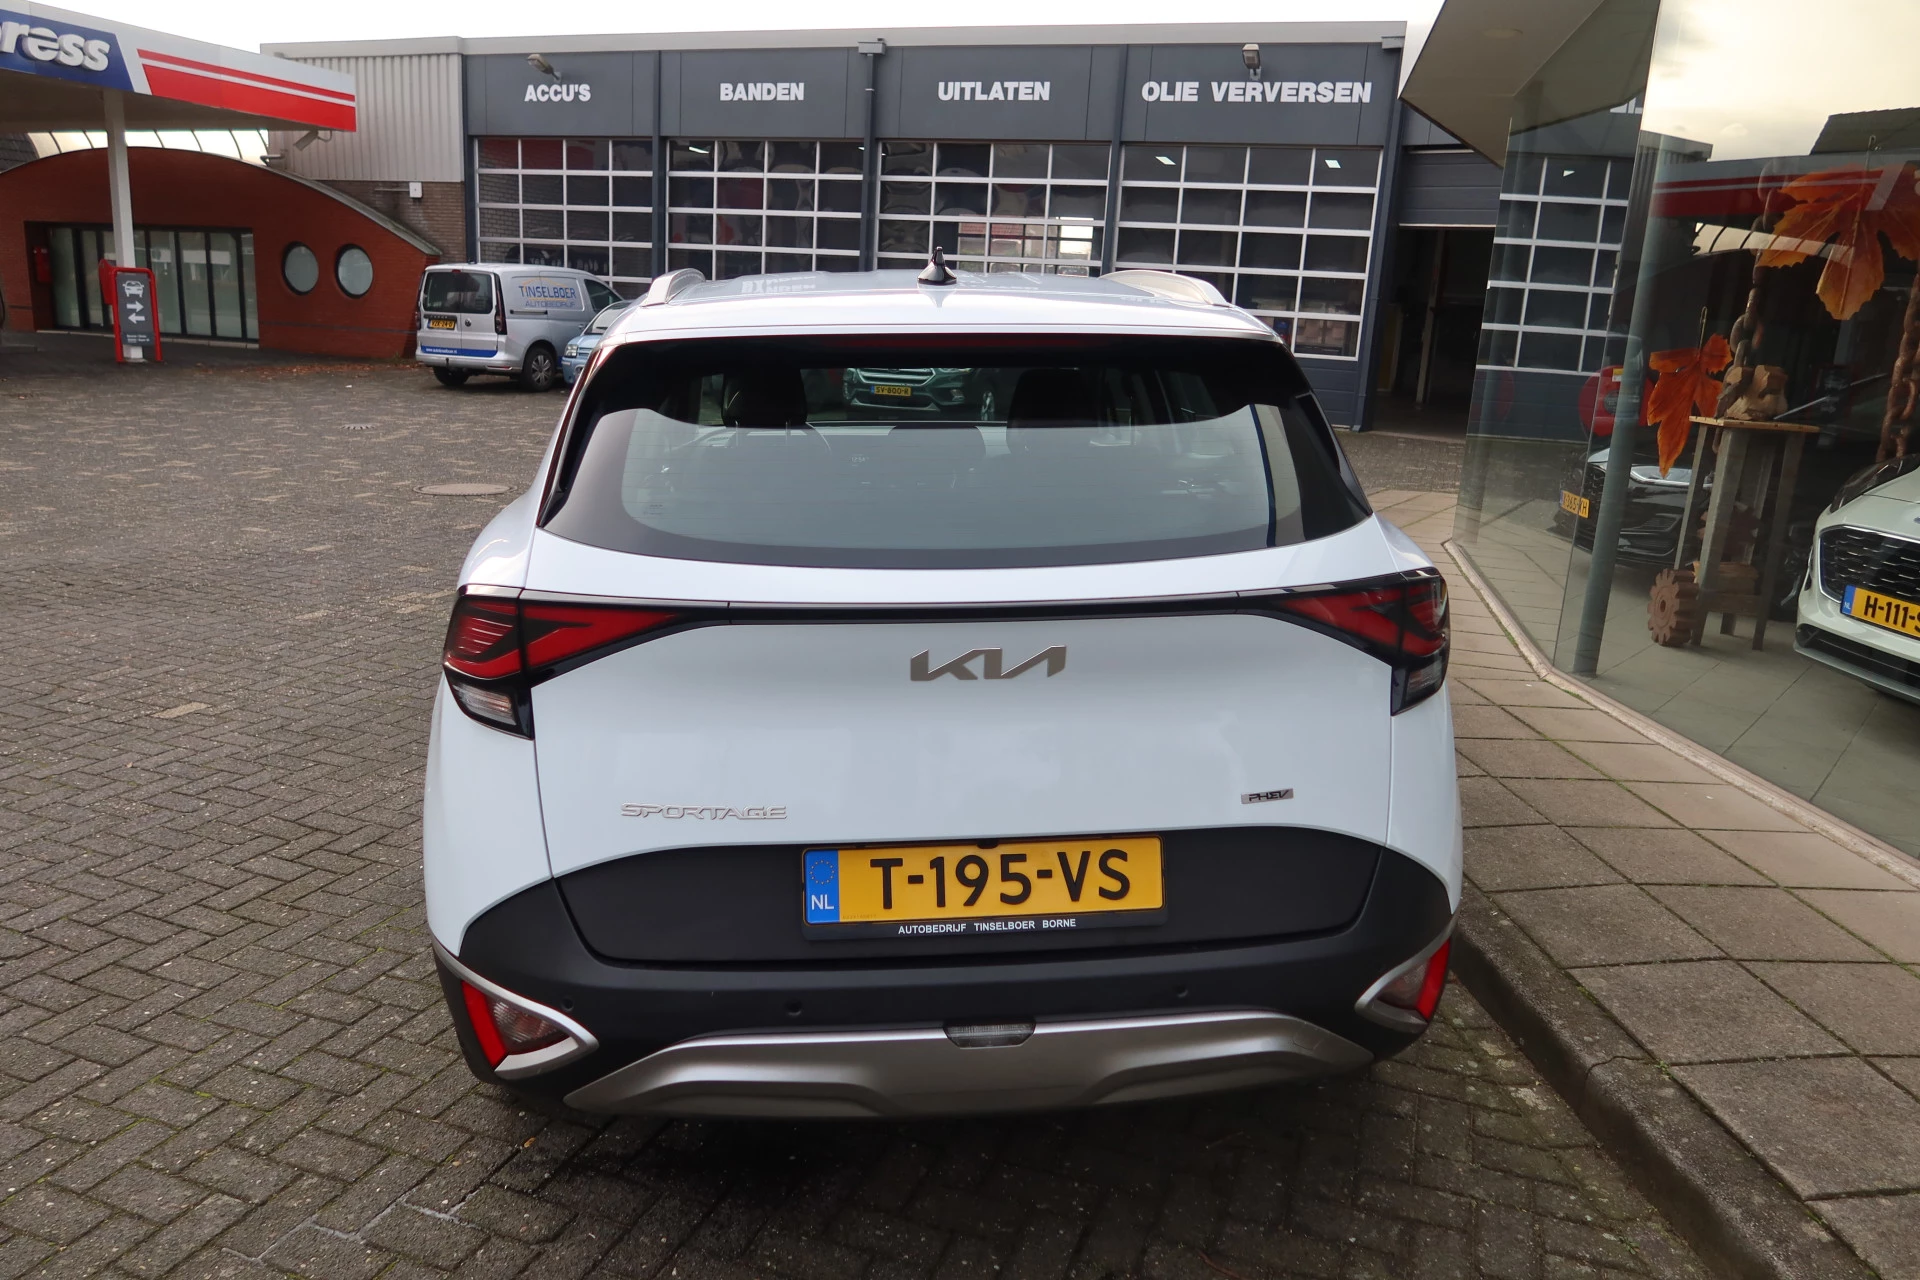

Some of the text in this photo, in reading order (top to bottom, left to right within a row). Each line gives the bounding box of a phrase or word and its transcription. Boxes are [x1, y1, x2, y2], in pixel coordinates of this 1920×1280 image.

[0, 21, 110, 71] ress
[524, 84, 591, 102] ACCU'S
[719, 82, 805, 101] BANDEN
[937, 81, 1050, 101] UITLATEN
[1141, 81, 1372, 103] OLIE VERVERSEN
[518, 285, 577, 299] TINSELBOER
[910, 645, 1067, 682] KIA
[1248, 789, 1290, 802] PHEV
[621, 802, 788, 820] SPORTAGE
[811, 848, 1131, 911] NL T-195-VS
[898, 918, 1077, 935] AUTOBEDRIJF TINSELBOER BORNE
